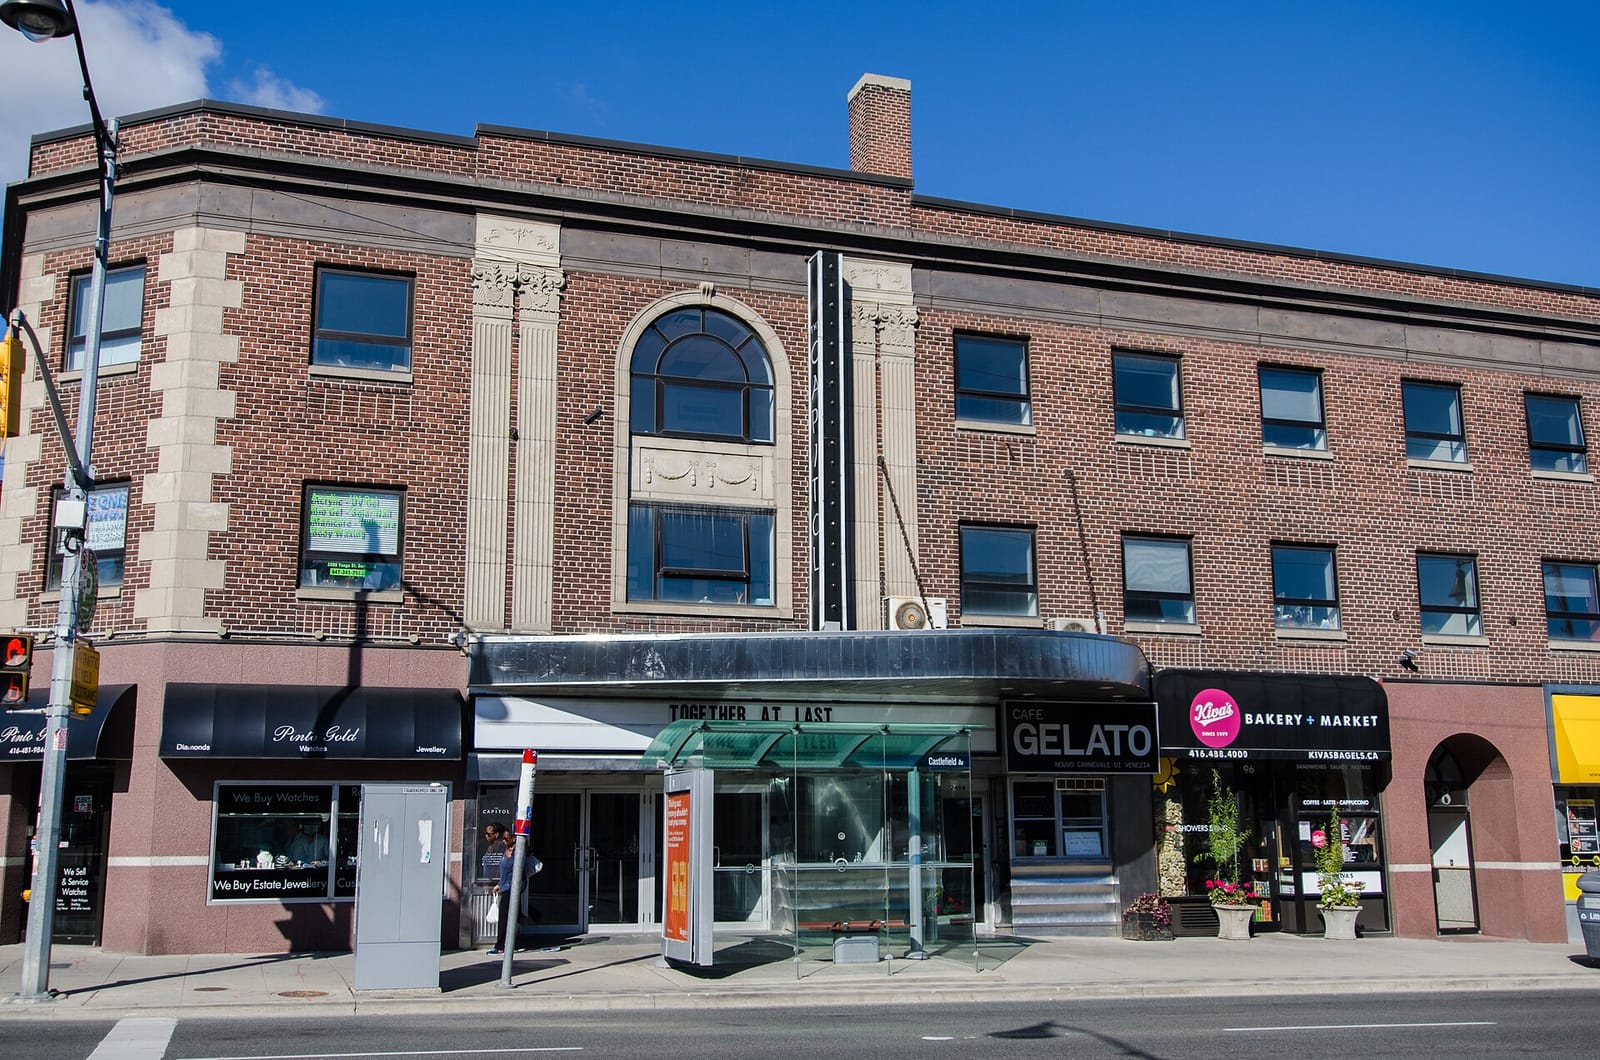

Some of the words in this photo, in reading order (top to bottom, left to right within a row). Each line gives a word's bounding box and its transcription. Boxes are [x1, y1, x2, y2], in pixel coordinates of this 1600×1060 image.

[810, 339, 820, 572] CAPITOL
[669, 704, 746, 722] TOGETHER
[761, 706, 781, 721] AT
[1194, 702, 1234, 722] Kiva's
[1245, 713, 1303, 725] BAKERY
[1320, 715, 1378, 727] MARKET
[0, 726, 33, 743] Pinto
[272, 725, 318, 742] Pinto
[323, 725, 360, 742] Gold
[1013, 722, 1152, 757] GELATO
[176, 743, 211, 751] Diamonds
[416, 745, 447, 754] Jewellery
[1188, 750, 1248, 758] 416.488.4000
[1308, 751, 1379, 760] KIVASBAGELS.CA
[928, 756, 957, 766] Castlefield
[233, 793, 251, 803] We
[254, 793, 273, 803] Buy
[276, 792, 320, 802] Watches
[63, 867, 75, 876] We
[75, 866, 87, 876] Sell
[67, 877, 89, 886] Service
[213, 880, 232, 890] We
[232, 880, 252, 893] Buy
[253, 879, 282, 890] Estate
[282, 878, 328, 891] Jewellery
[61, 887, 87, 896] Watches
